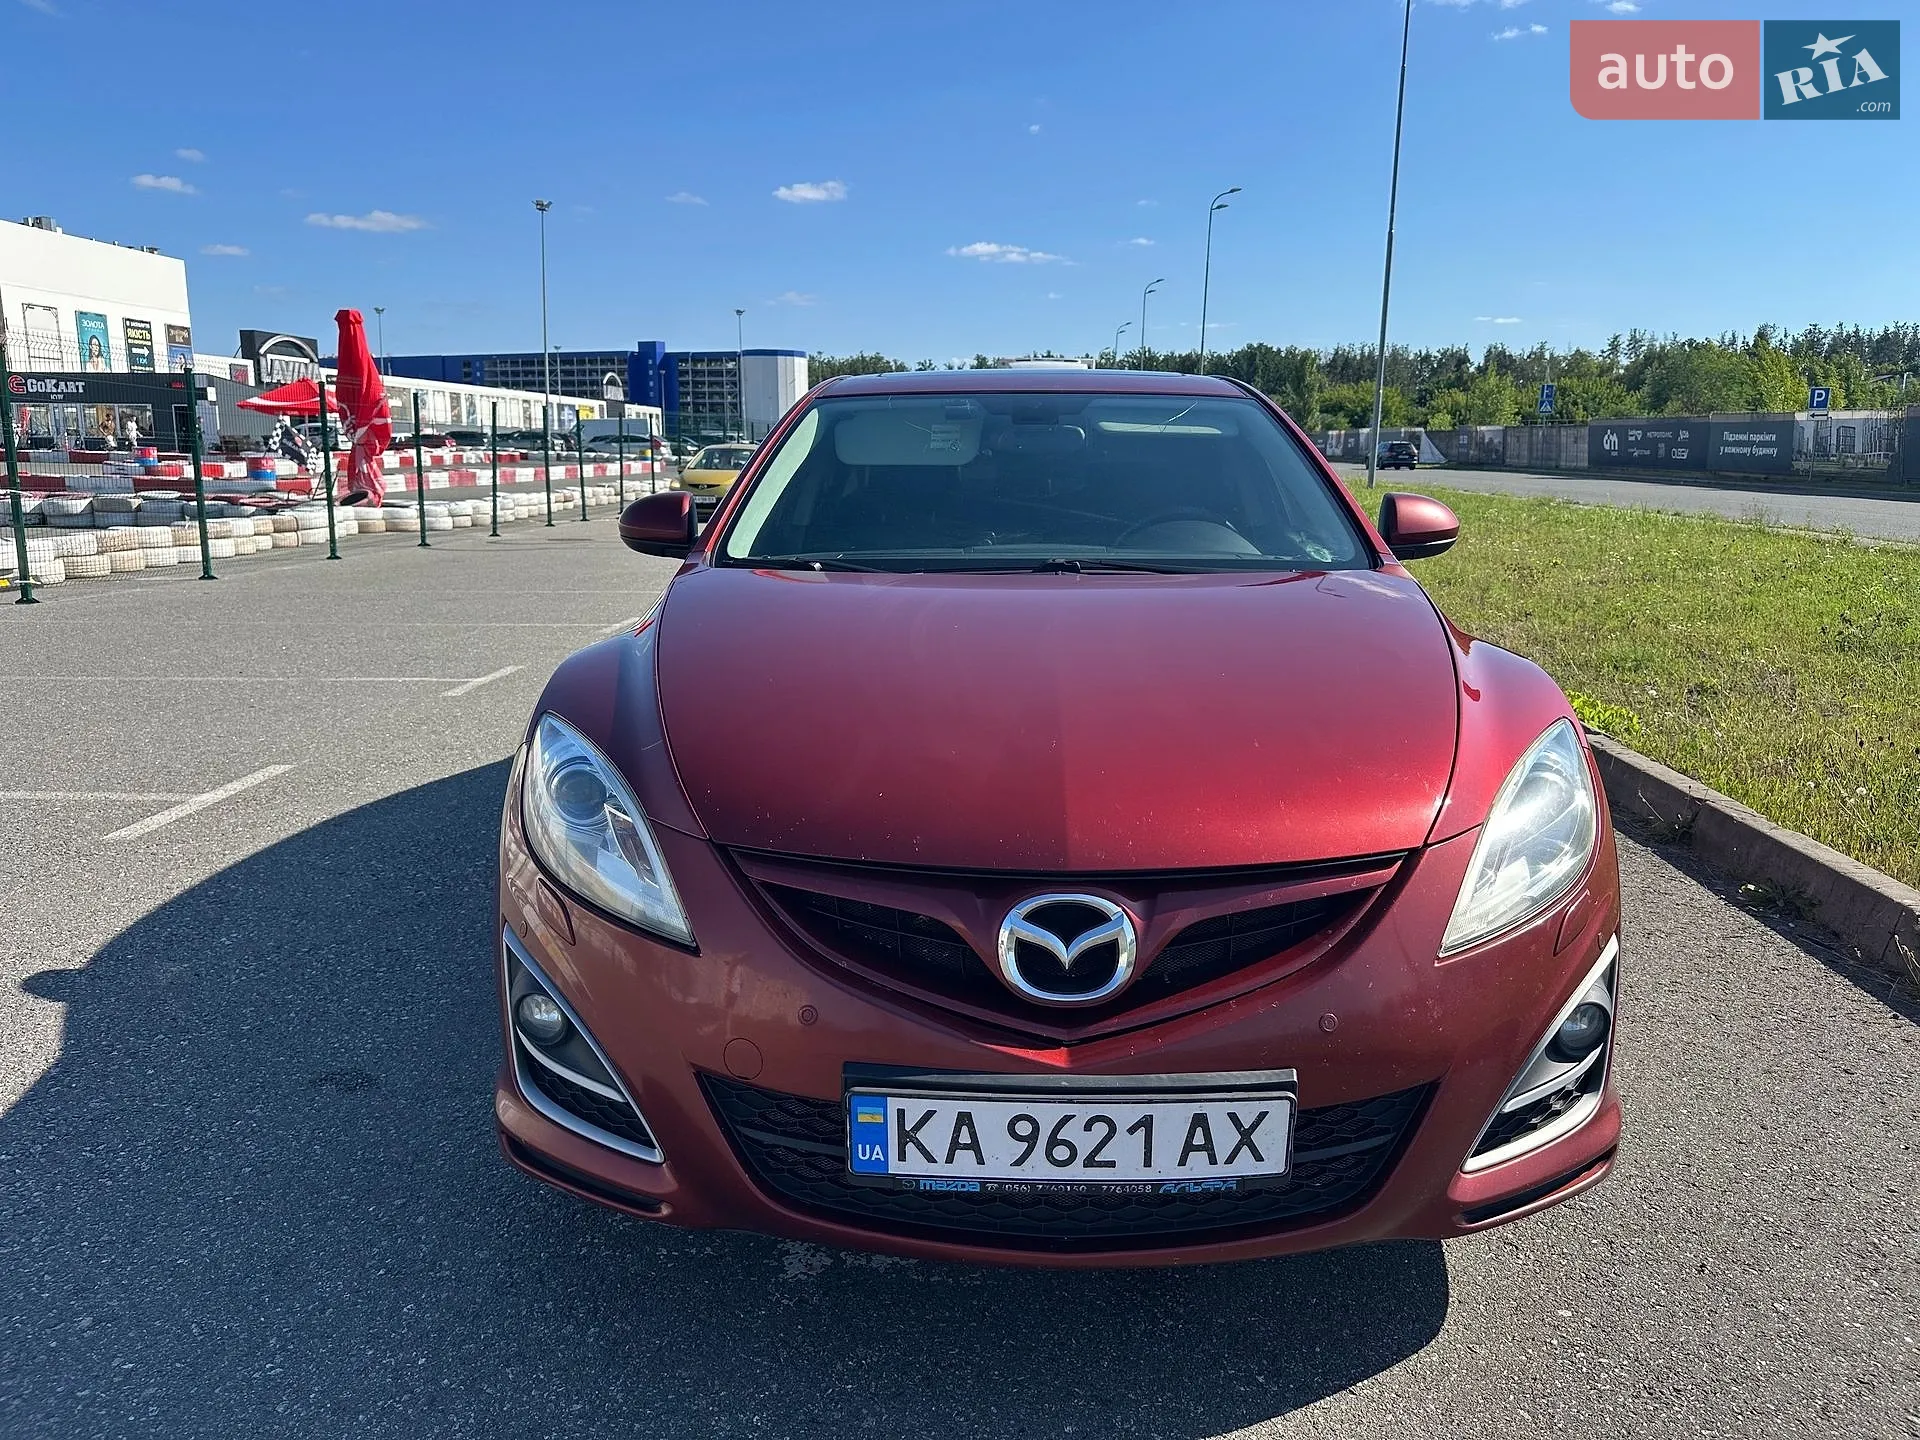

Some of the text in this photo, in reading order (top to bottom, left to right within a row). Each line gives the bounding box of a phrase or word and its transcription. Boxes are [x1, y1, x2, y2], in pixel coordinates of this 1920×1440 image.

[259, 354, 322, 384] LAVINA
[1813, 389, 1826, 407] P
[1723, 431, 1776, 443] Підземні паркінги
[1719, 444, 1778, 457] у кожному будинку
[896, 1107, 1270, 1169] KA 9621 AX
[858, 1144, 885, 1162] UA
